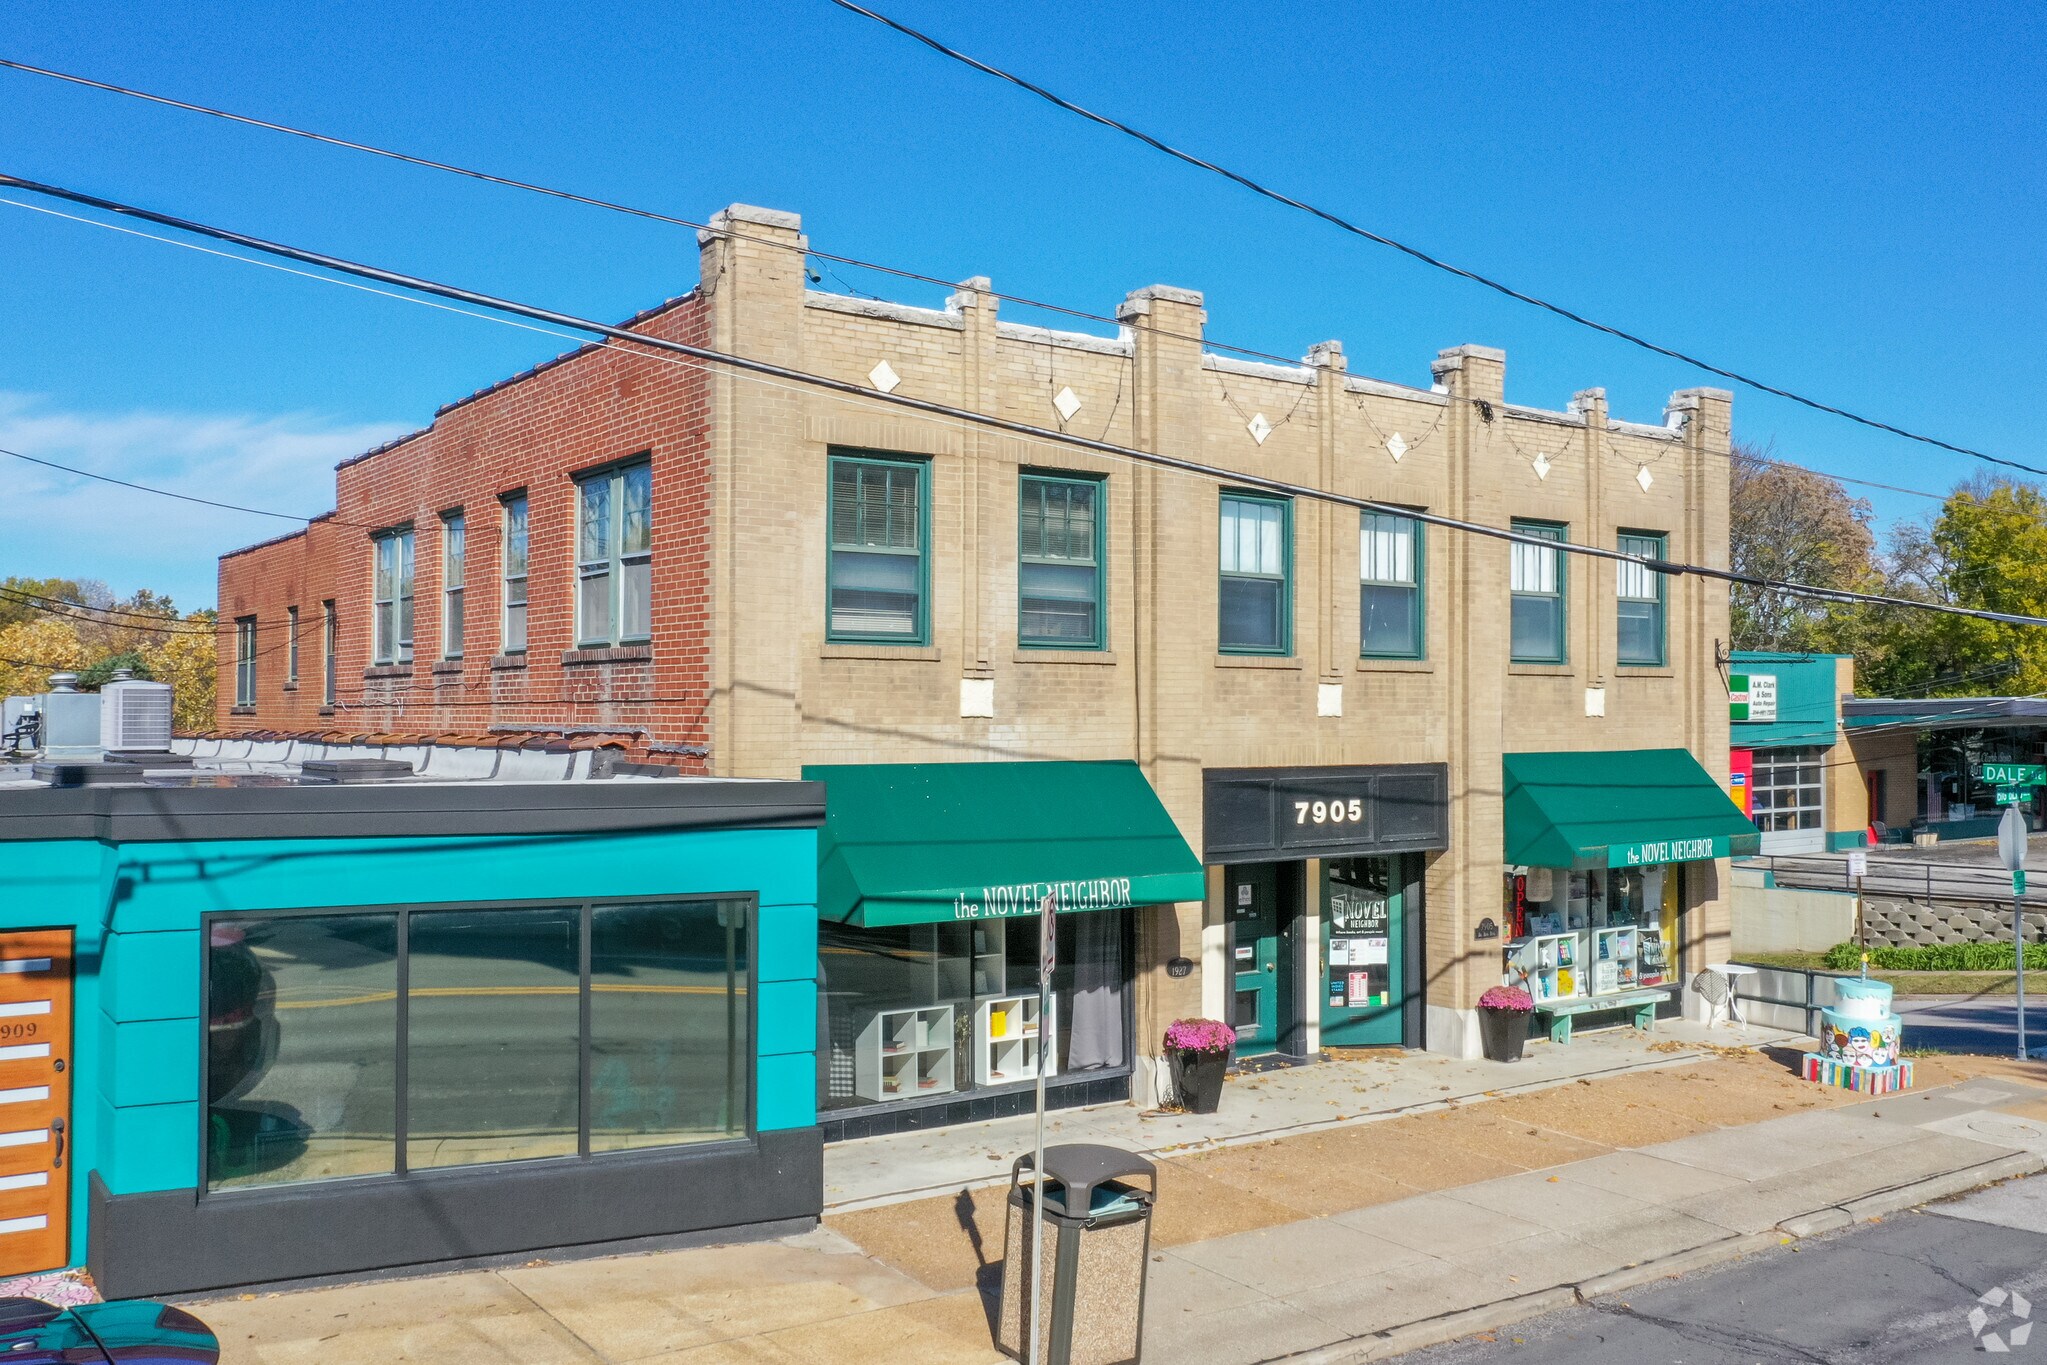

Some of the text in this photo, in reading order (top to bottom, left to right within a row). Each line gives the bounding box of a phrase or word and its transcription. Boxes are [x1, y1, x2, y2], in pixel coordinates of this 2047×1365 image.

[1731, 693, 1748, 702] Castrol
[1986, 766, 2027, 781] DALE
[1294, 799, 1362, 825] 7905
[1627, 838, 1713, 865] the NOVEL NEIGHBOR
[954, 892, 979, 919] the
[983, 883, 1044, 916] NOVEL
[1344, 900, 1387, 920] NOVEL
[1515, 876, 1525, 937] OPEN
[1350, 920, 1379, 928] NEIGHBOR
[1172, 965, 1187, 976] 1927
[0, 1022, 37, 1039] 909
